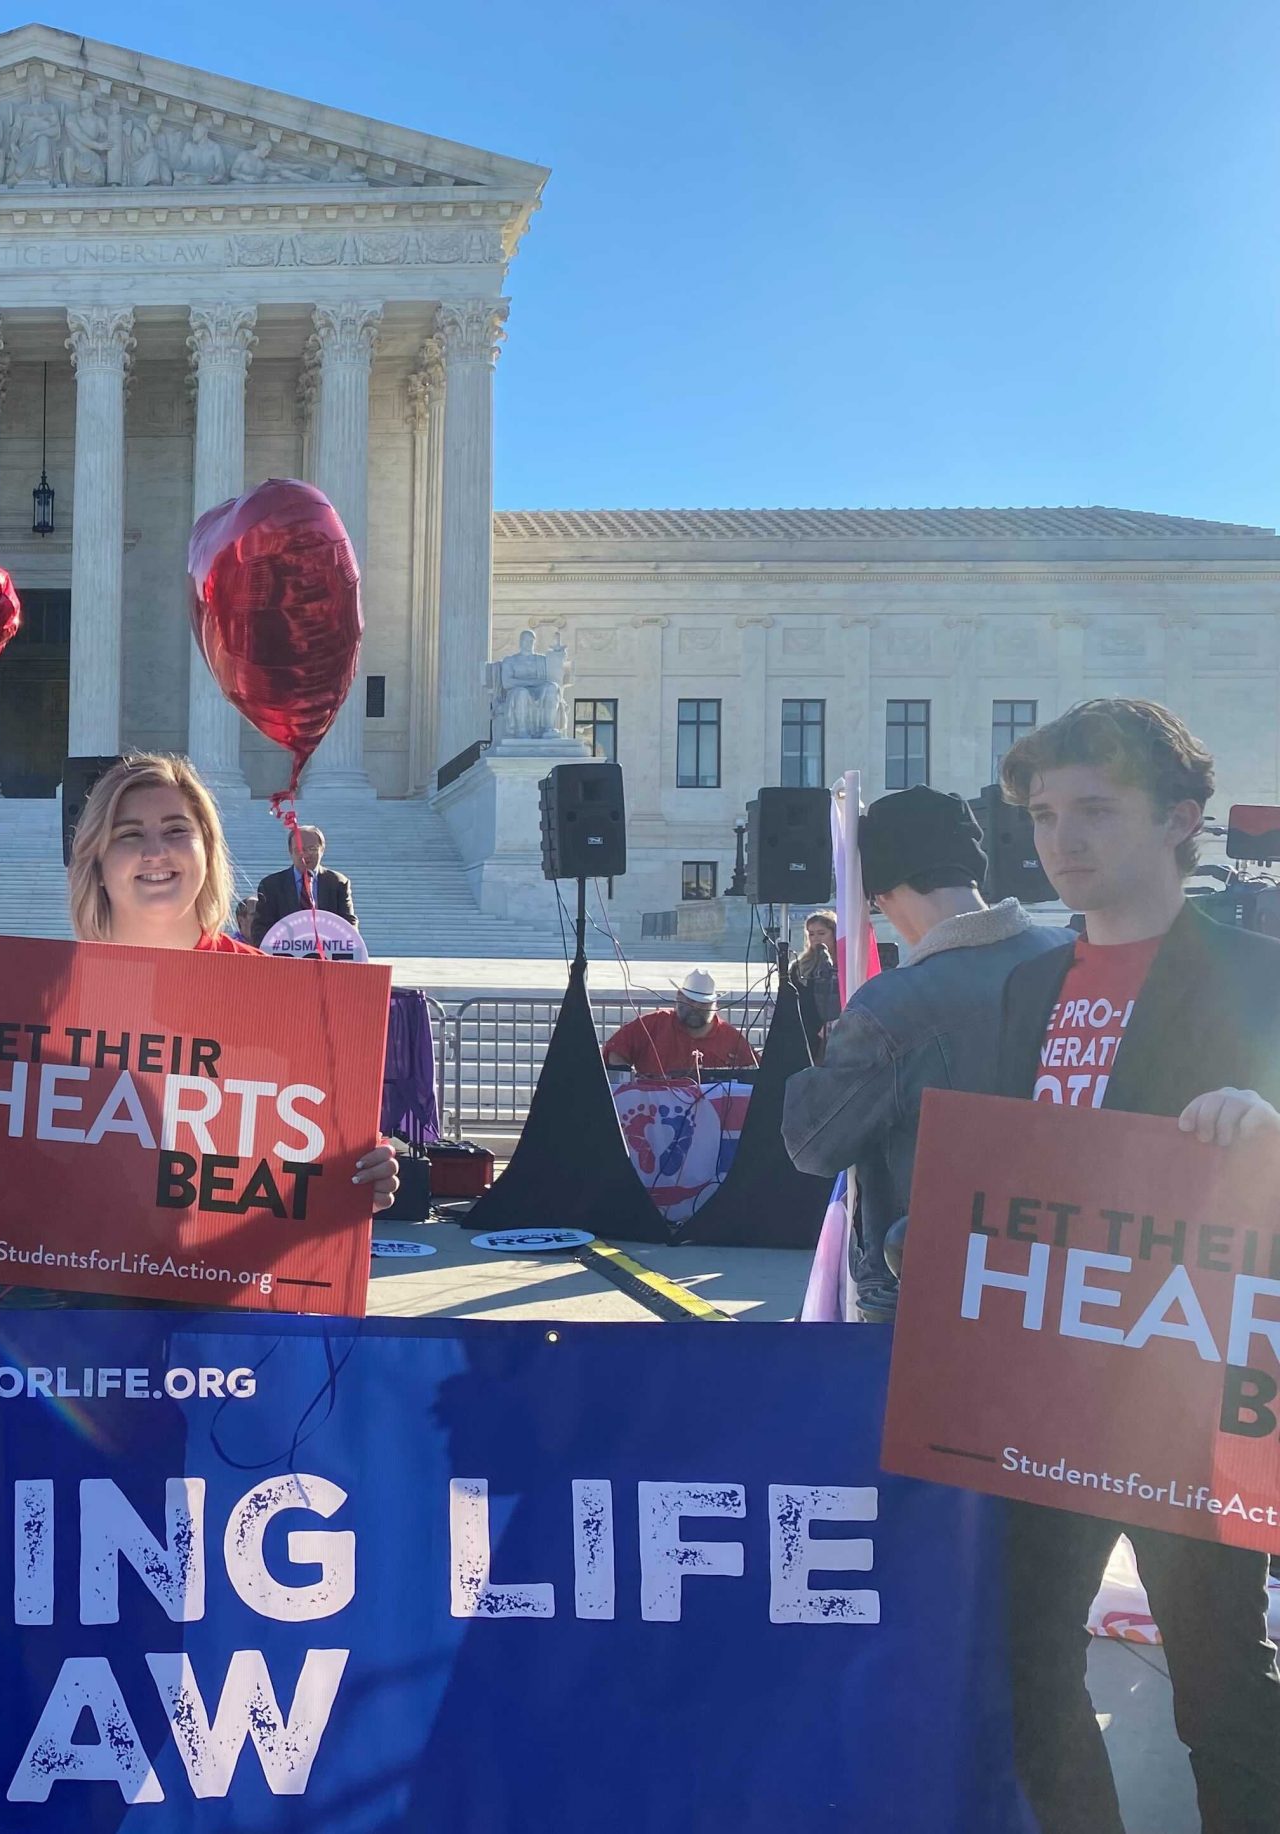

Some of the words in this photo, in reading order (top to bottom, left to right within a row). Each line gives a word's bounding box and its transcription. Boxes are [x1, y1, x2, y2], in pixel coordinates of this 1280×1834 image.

[64, 244, 150, 264] UNDER
[159, 243, 208, 262] LAW
[64, 1027, 221, 1078] THEIR
[1040, 1036, 1122, 1067] NERAT
[155, 1150, 323, 1220] BEAT
[487, 1235, 581, 1246] ROE
[971, 1191, 1080, 1247] LET
[961, 1233, 1280, 1368] HEAR
[1001, 1447, 1280, 1526] StudentsforLifeAct
[449, 1477, 881, 1624] LIFE
